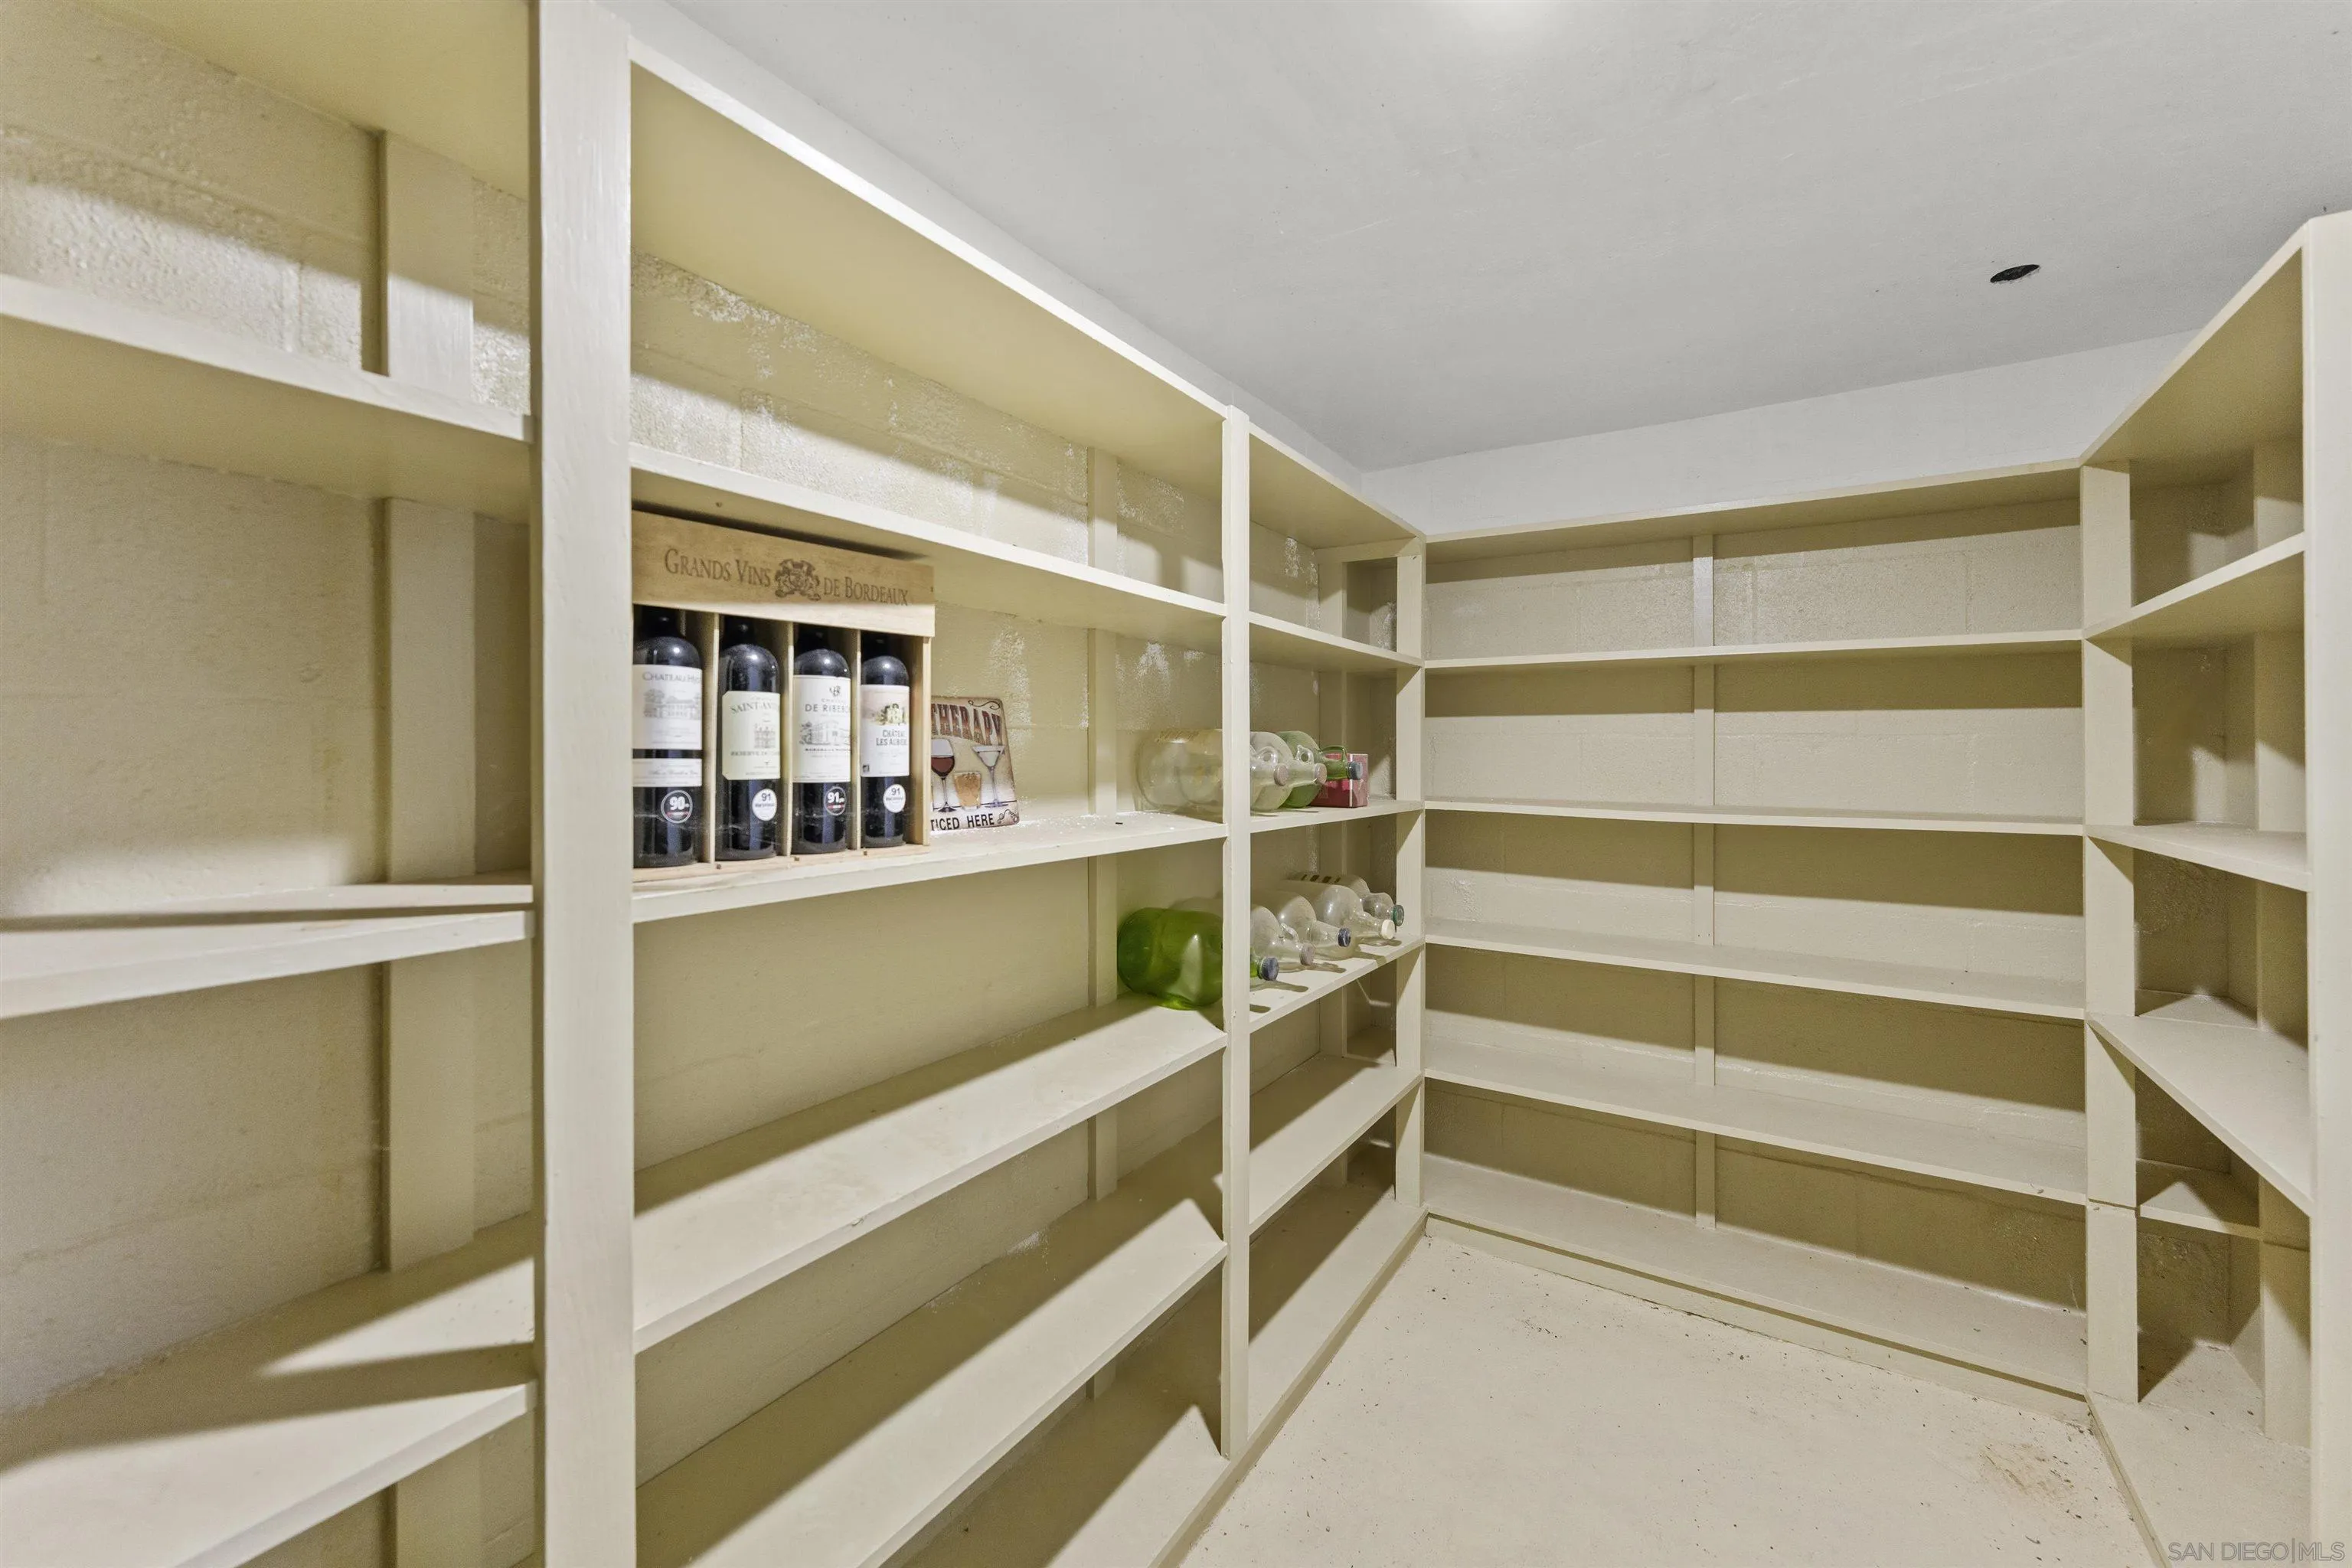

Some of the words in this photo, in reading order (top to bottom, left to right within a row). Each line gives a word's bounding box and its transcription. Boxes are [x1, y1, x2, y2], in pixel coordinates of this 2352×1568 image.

[665, 547, 731, 583] GRANDS
[735, 558, 771, 588] VINS
[823, 577, 841, 597] DE
[844, 576, 909, 607] BORDEAUX
[805, 704, 818, 712] DE
[762, 792, 771, 802] 91
[827, 792, 840, 804] 91
[966, 813, 995, 828] HERE
